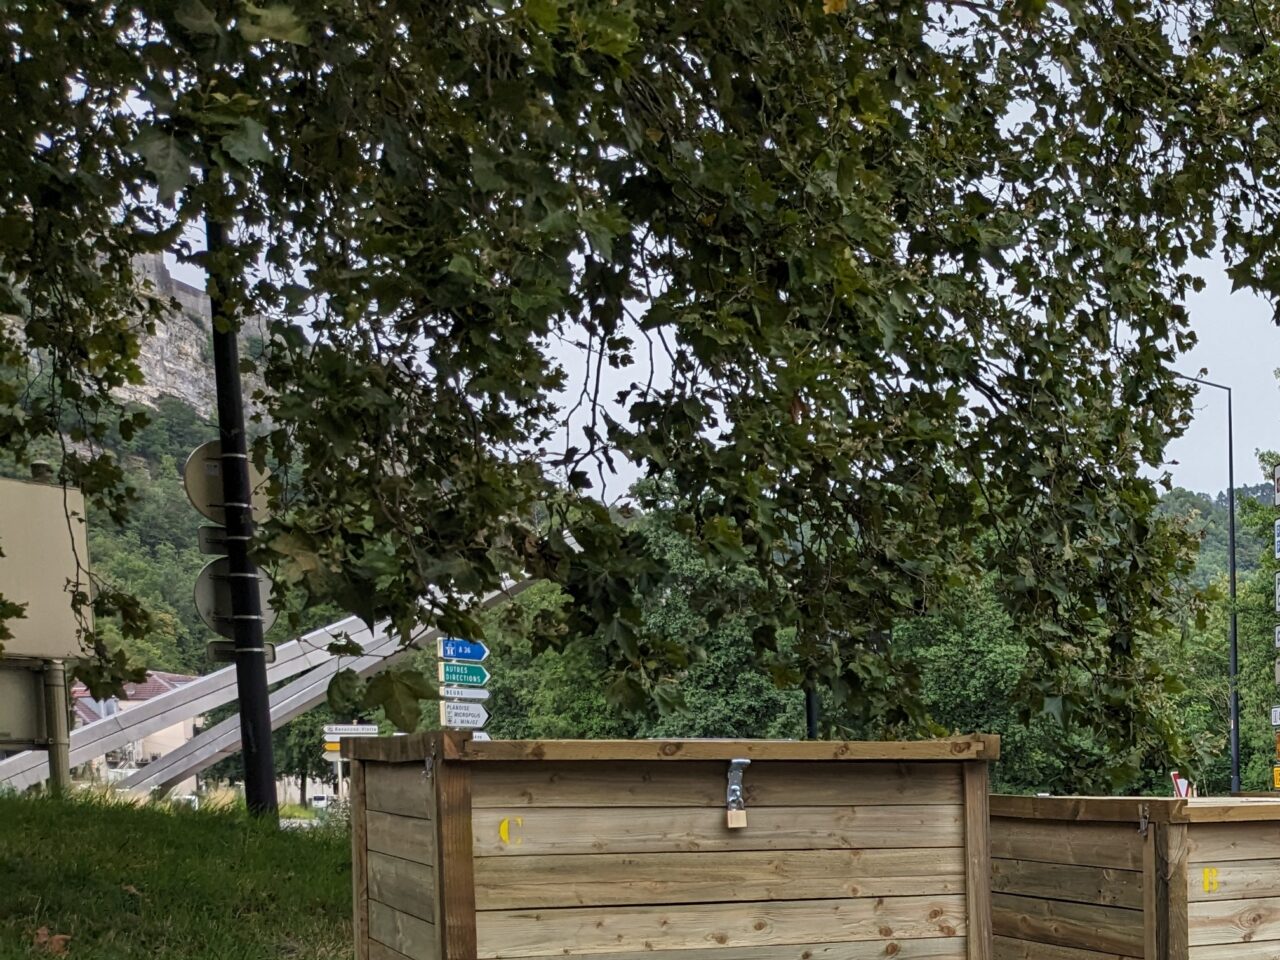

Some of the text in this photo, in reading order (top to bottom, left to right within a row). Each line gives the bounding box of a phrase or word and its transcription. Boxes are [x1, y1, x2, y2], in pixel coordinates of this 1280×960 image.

[446, 665, 468, 674] AUTRES
[446, 674, 481, 683] DIRECTIONS
[499, 816, 523, 846] C
[1203, 866, 1217, 893] B
